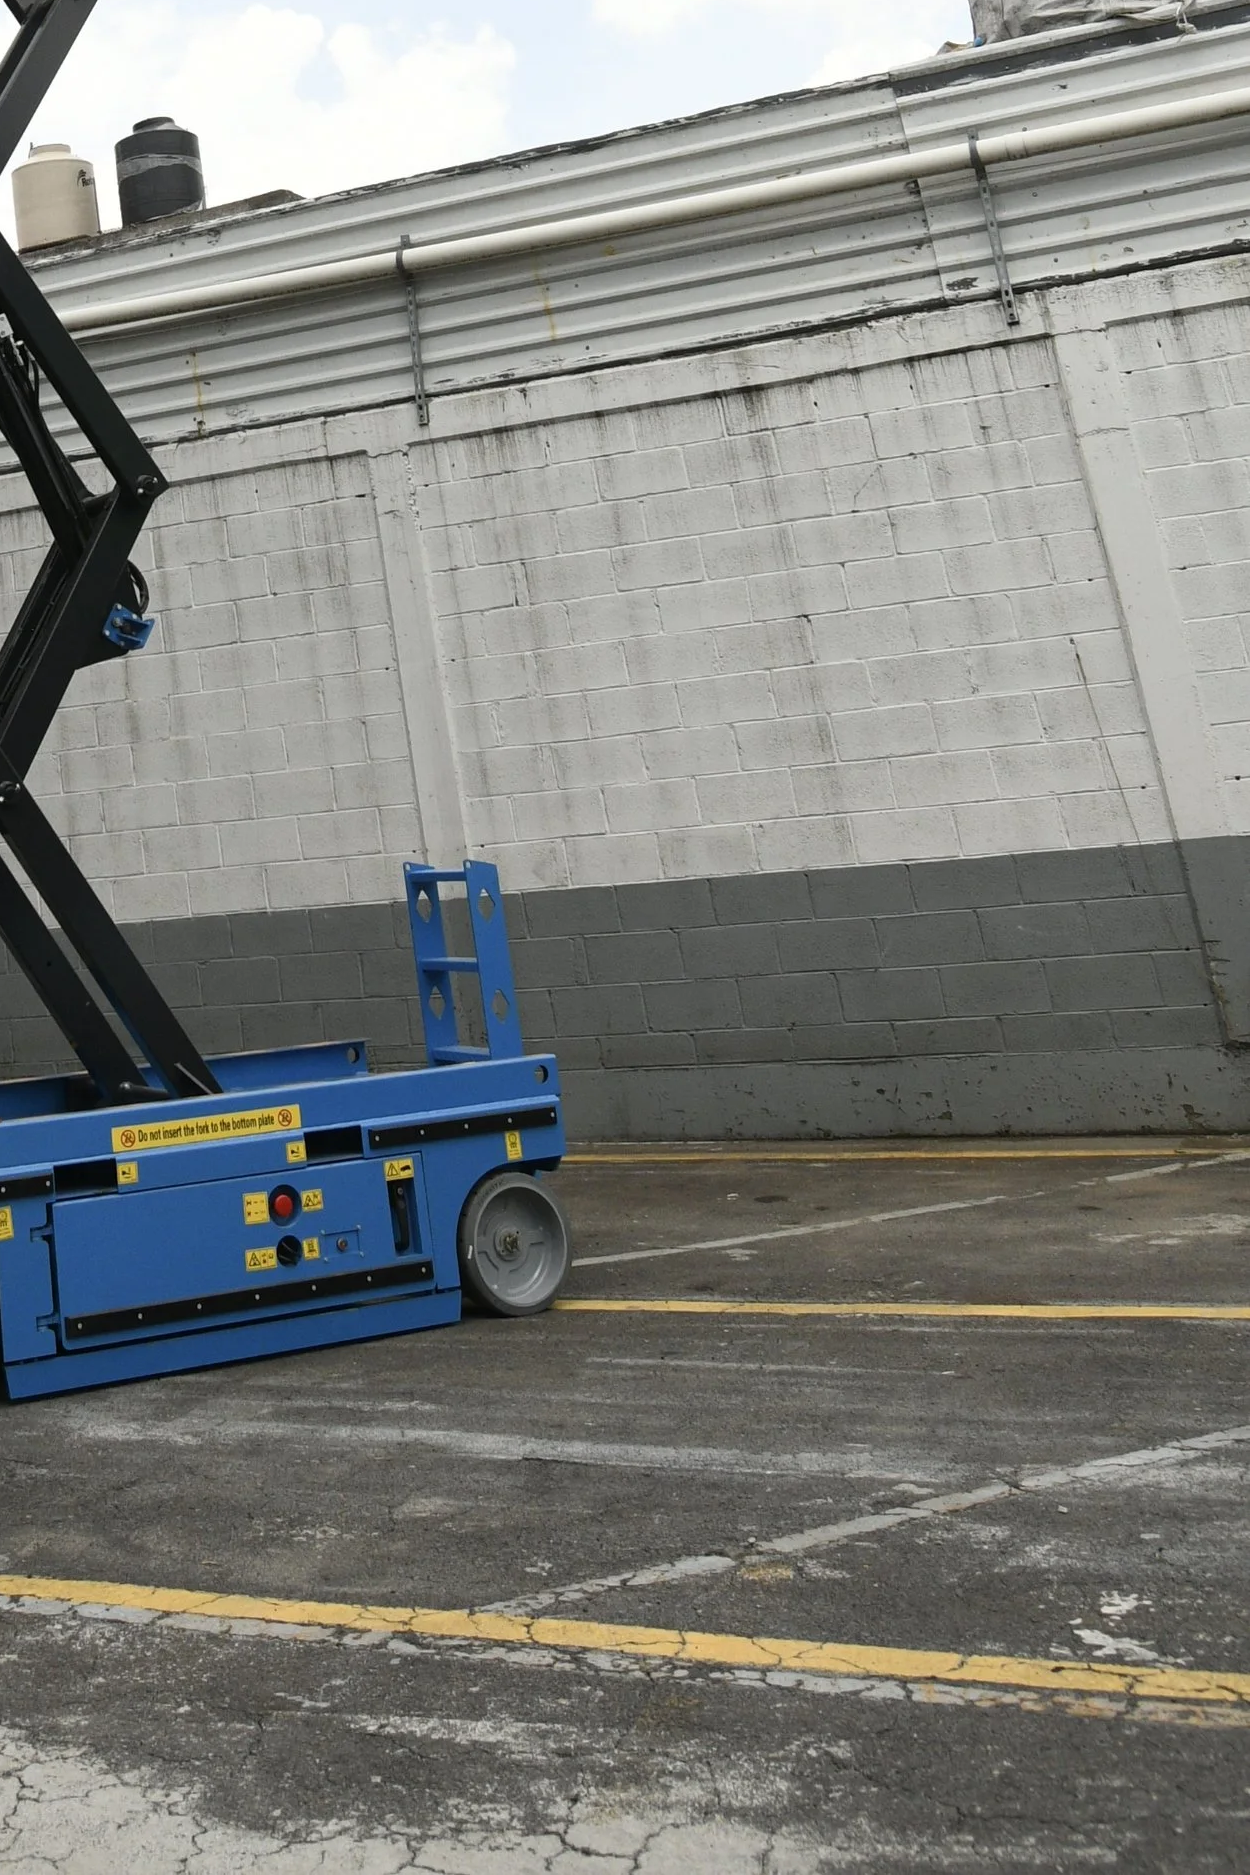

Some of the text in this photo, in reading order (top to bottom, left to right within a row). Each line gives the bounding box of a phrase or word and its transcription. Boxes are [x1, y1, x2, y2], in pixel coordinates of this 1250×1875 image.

[138, 1113, 275, 1142] Do not insert the fork to the bottom plate
